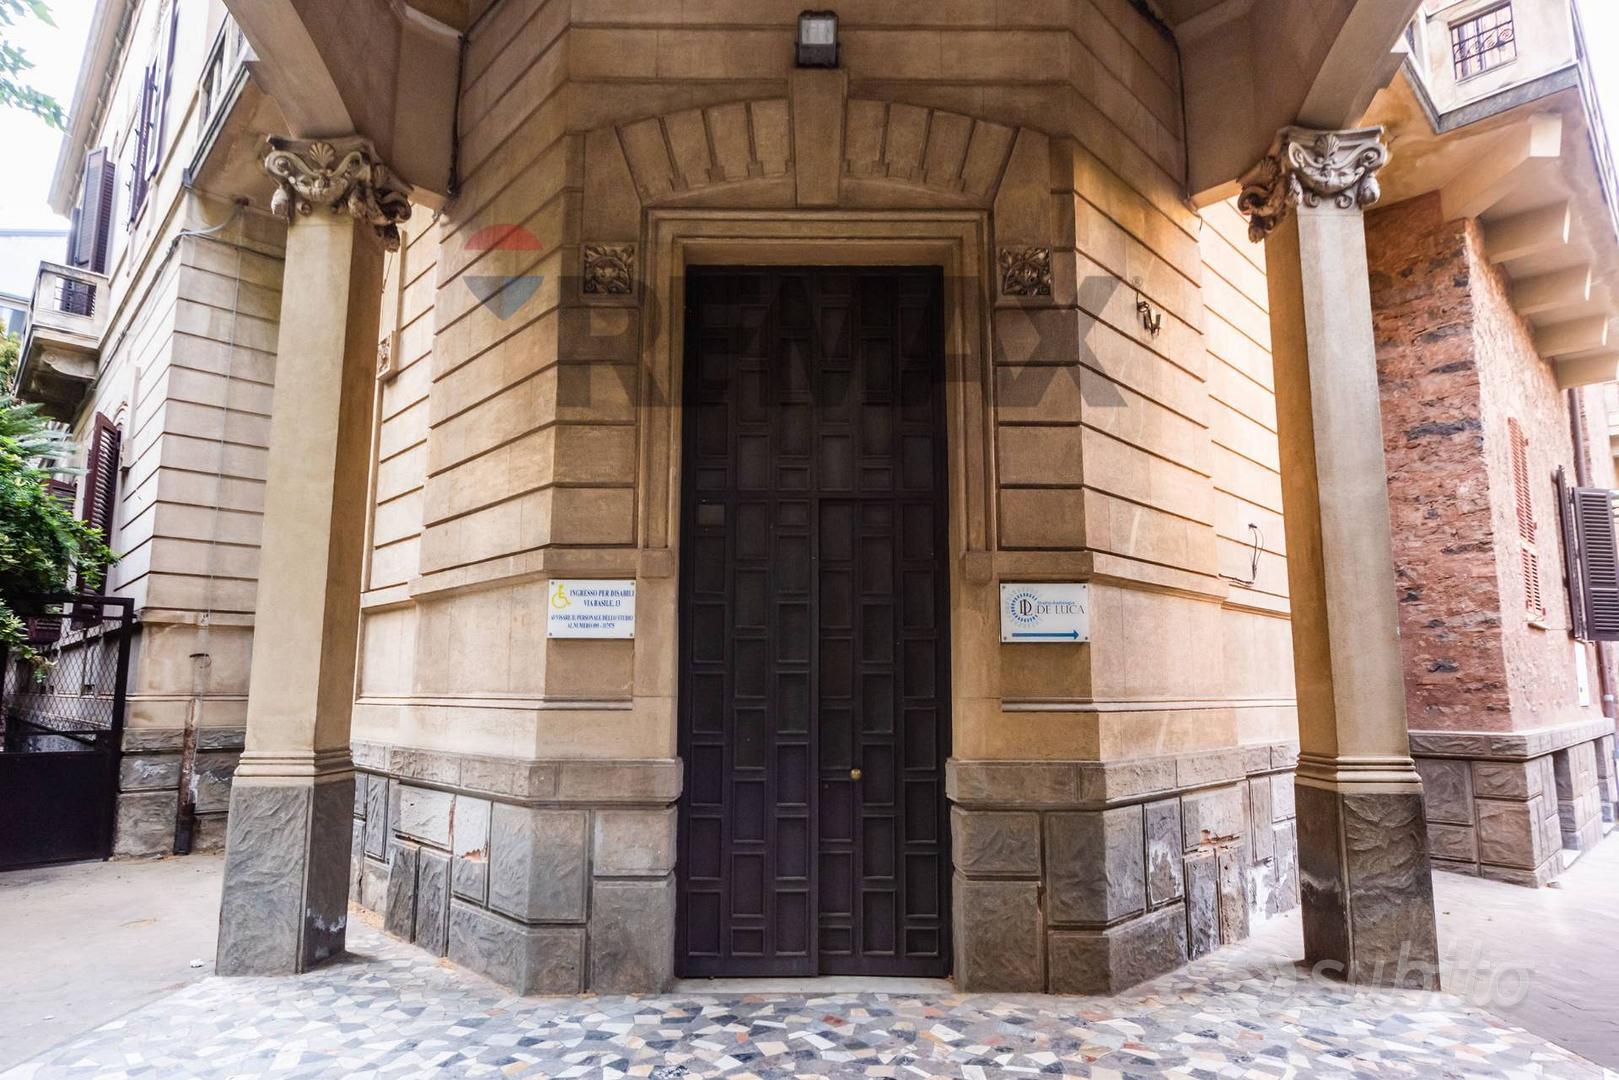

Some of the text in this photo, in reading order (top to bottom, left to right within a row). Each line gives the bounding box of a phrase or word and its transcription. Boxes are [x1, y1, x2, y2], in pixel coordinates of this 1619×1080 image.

[569, 589, 597, 597] INGRESSO
[598, 589, 609, 597] PER
[1036, 605, 1085, 614] DE LUCA
